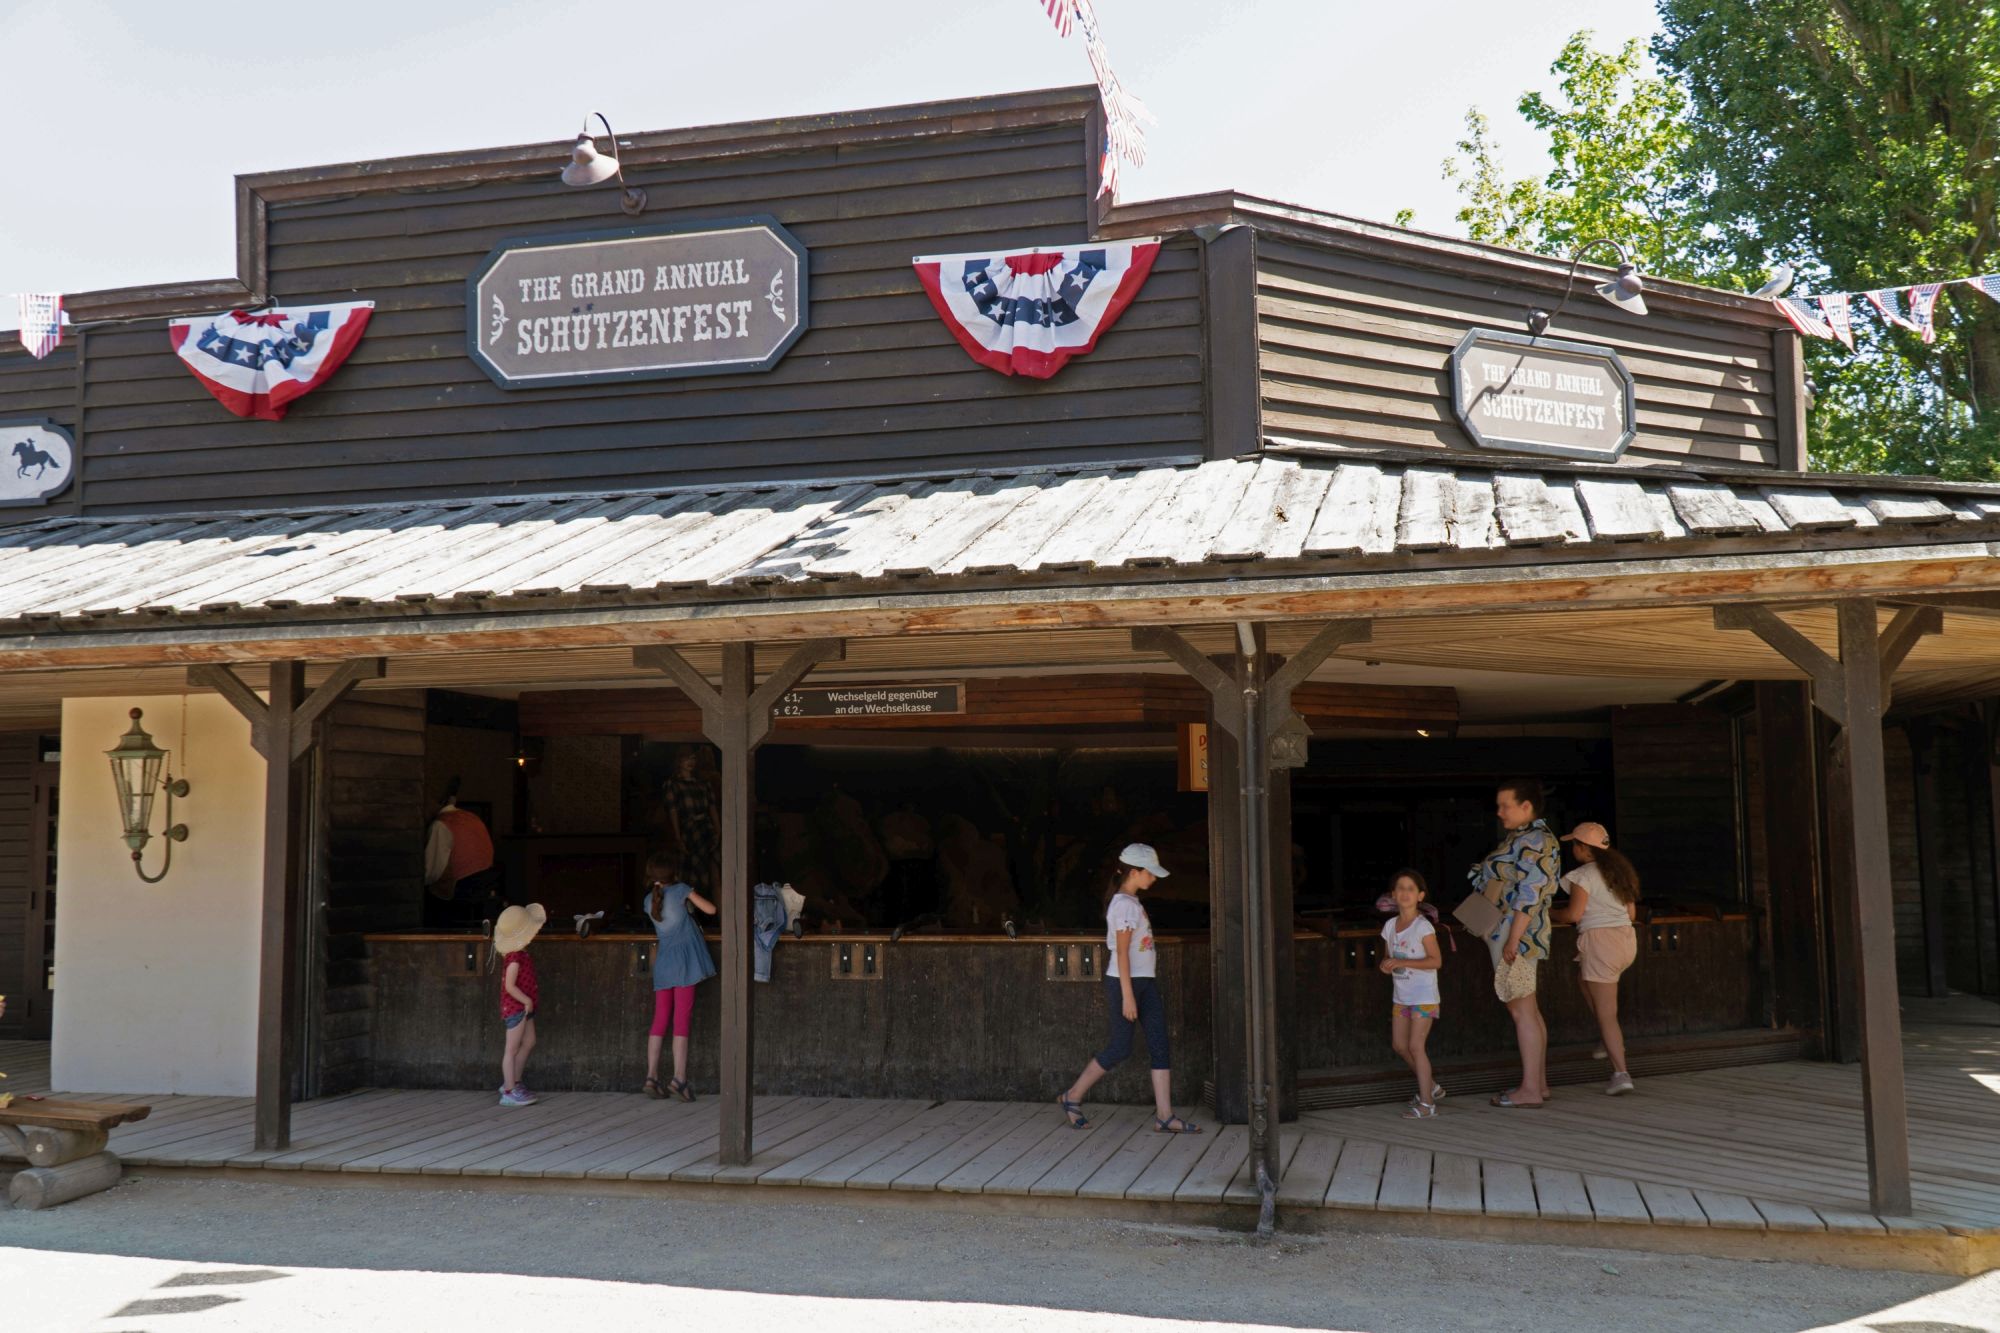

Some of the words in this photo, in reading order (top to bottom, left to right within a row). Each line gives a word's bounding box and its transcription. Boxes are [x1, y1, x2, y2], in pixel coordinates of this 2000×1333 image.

[519, 276, 561, 303] THE
[571, 268, 645, 299] GRAND
[653, 258, 750, 292] ANNUAL
[1482, 362, 1507, 382] THE
[1511, 367, 1551, 389] GRAND
[1556, 373, 1604, 397] ANNUAL
[827, 690, 886, 703] Wechselgeld
[888, 689, 938, 702] gegenüber
[835, 706, 846, 714] an
[848, 704, 864, 714] der
[865, 703, 932, 714] Wechselkasse
